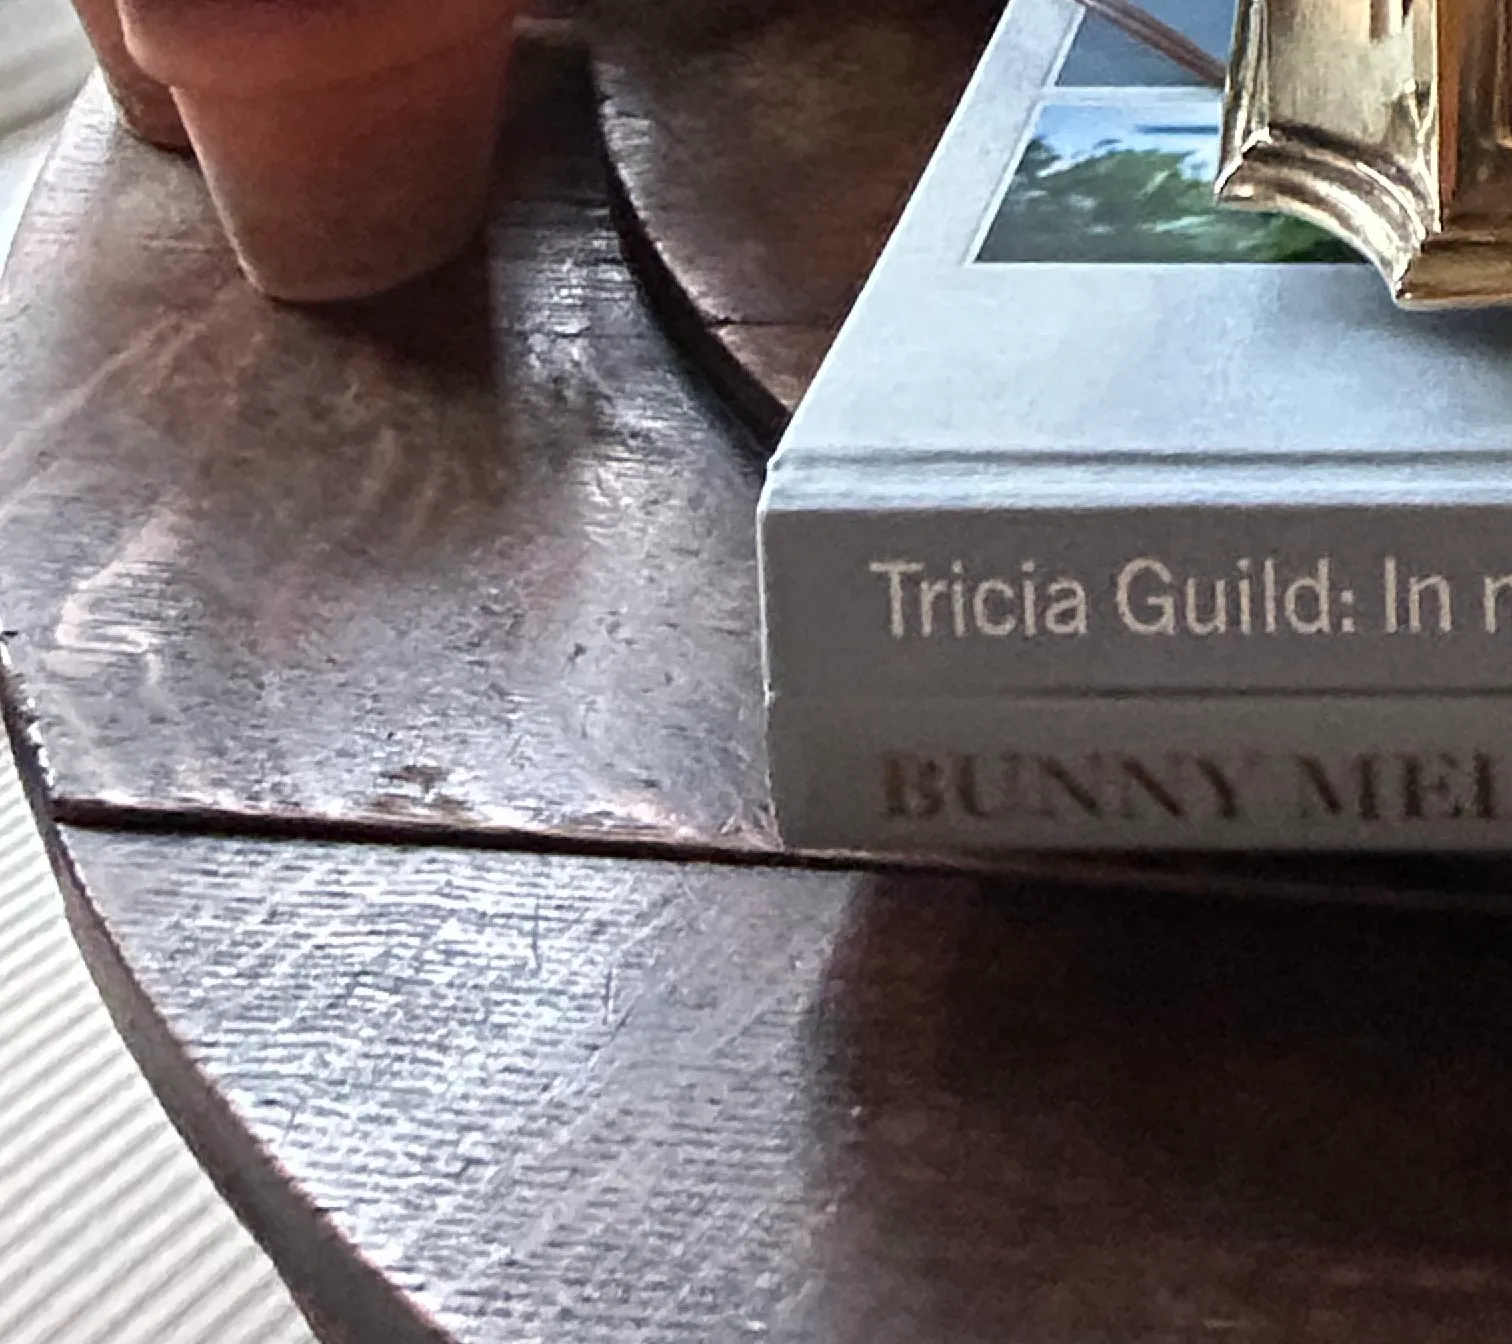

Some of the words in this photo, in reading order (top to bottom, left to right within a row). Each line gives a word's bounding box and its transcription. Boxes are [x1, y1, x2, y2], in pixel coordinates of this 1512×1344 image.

[868, 558, 1088, 638] Tricia
[1115, 556, 1356, 636] Guild:
[1383, 555, 1452, 634] In
[882, 749, 1264, 820] BUNNY
